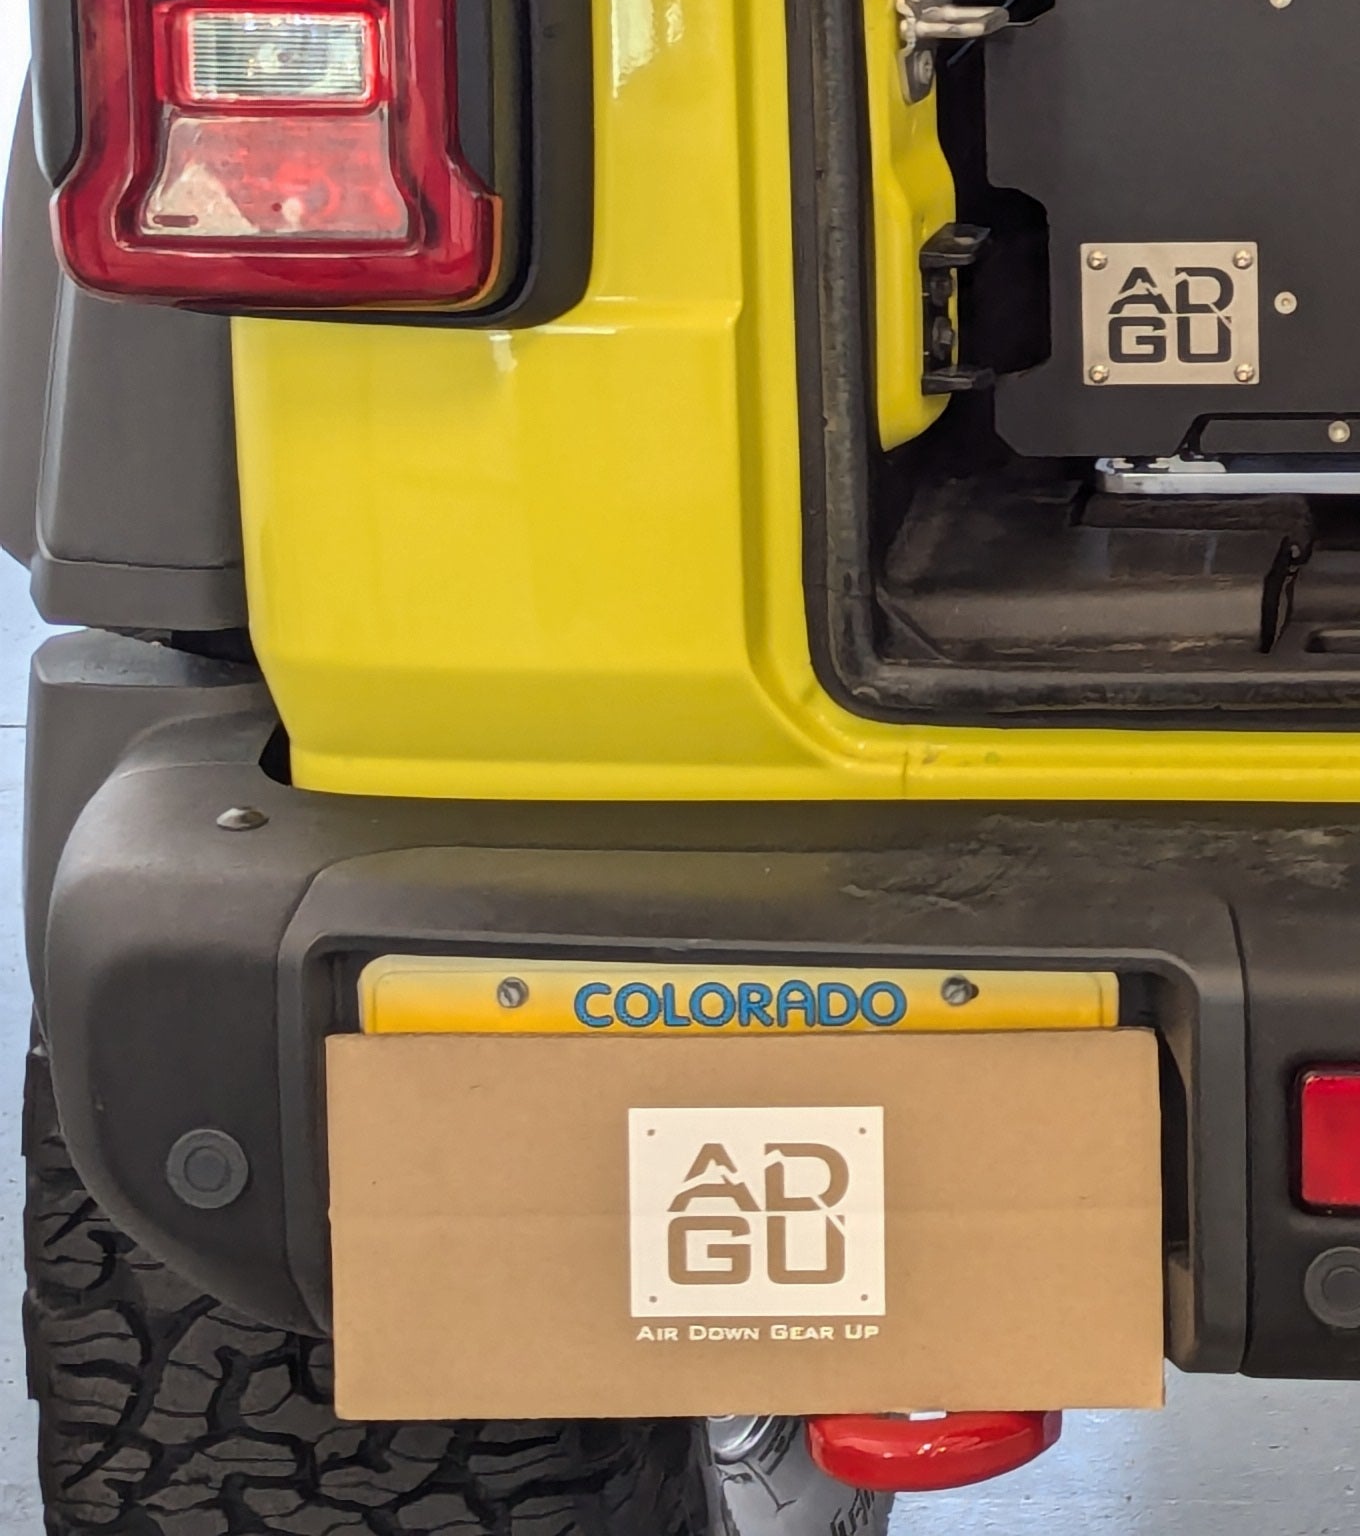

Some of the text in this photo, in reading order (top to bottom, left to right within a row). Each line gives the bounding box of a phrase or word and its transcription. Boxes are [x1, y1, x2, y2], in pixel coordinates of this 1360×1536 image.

[1108, 267, 1234, 314] AD
[1108, 316, 1232, 363] GU
[574, 979, 907, 1028] COLORADO
[667, 1142, 850, 1212] AD
[667, 1215, 846, 1285] GU
[845, 1324, 880, 1340] UP
